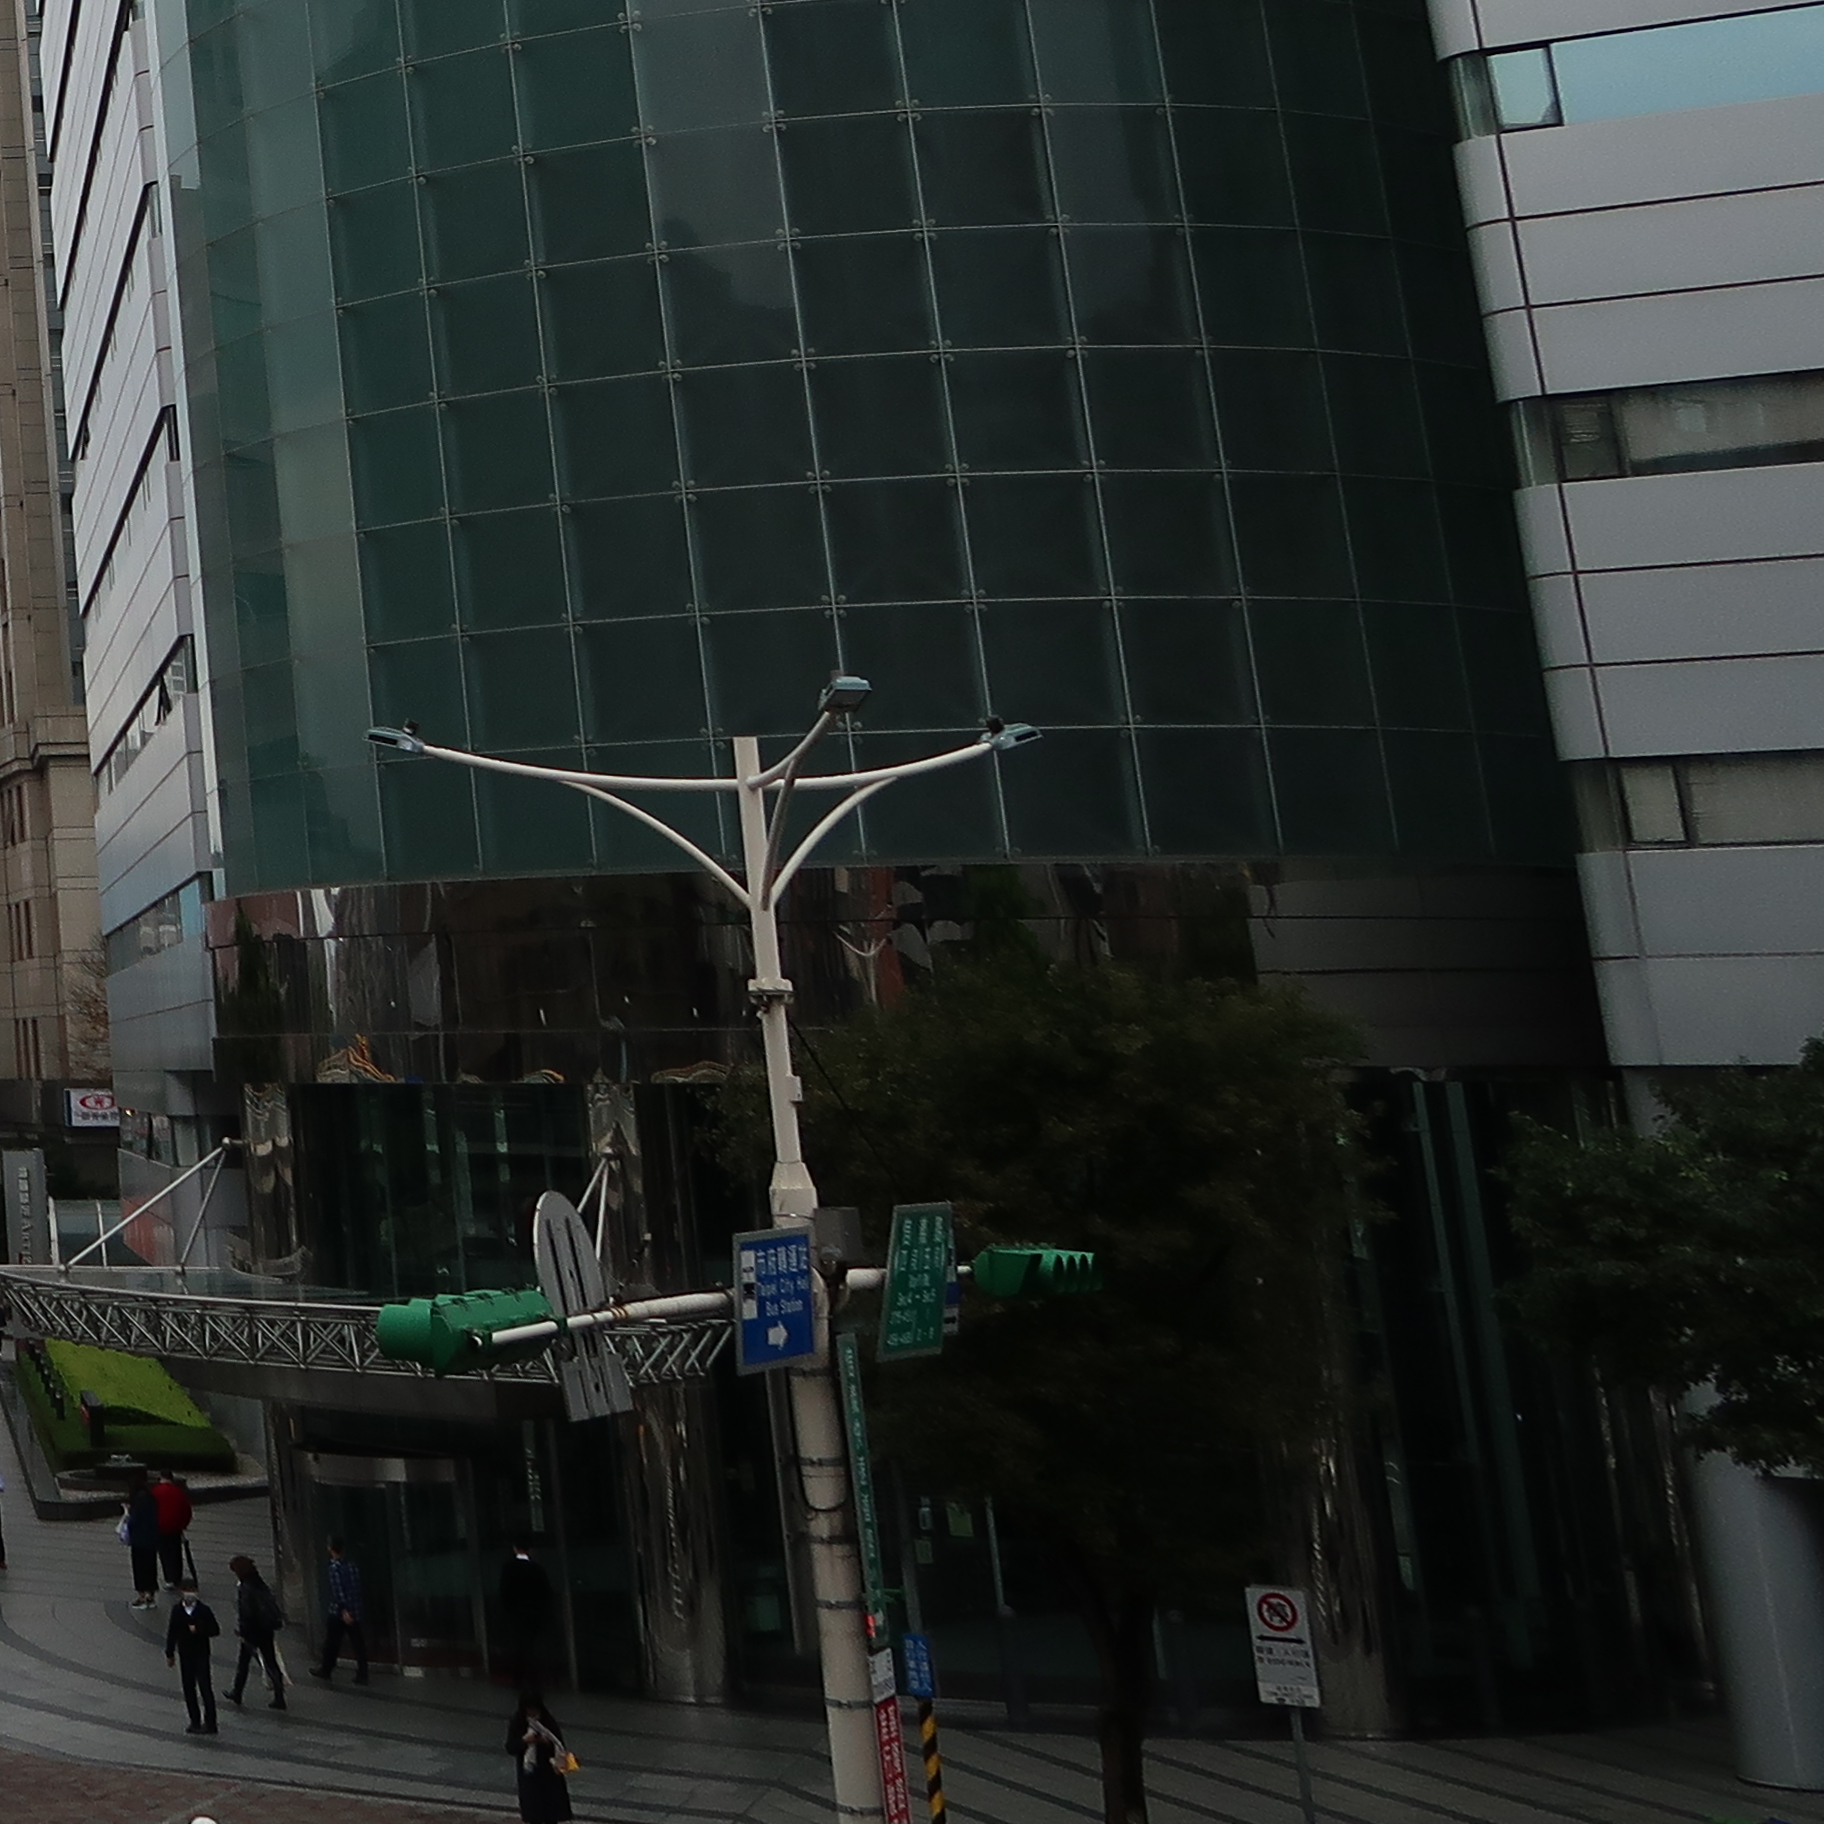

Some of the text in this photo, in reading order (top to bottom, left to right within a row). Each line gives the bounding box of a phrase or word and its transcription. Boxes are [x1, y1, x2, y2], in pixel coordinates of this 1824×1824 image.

[757, 1243, 808, 1275] 市府轉運站
